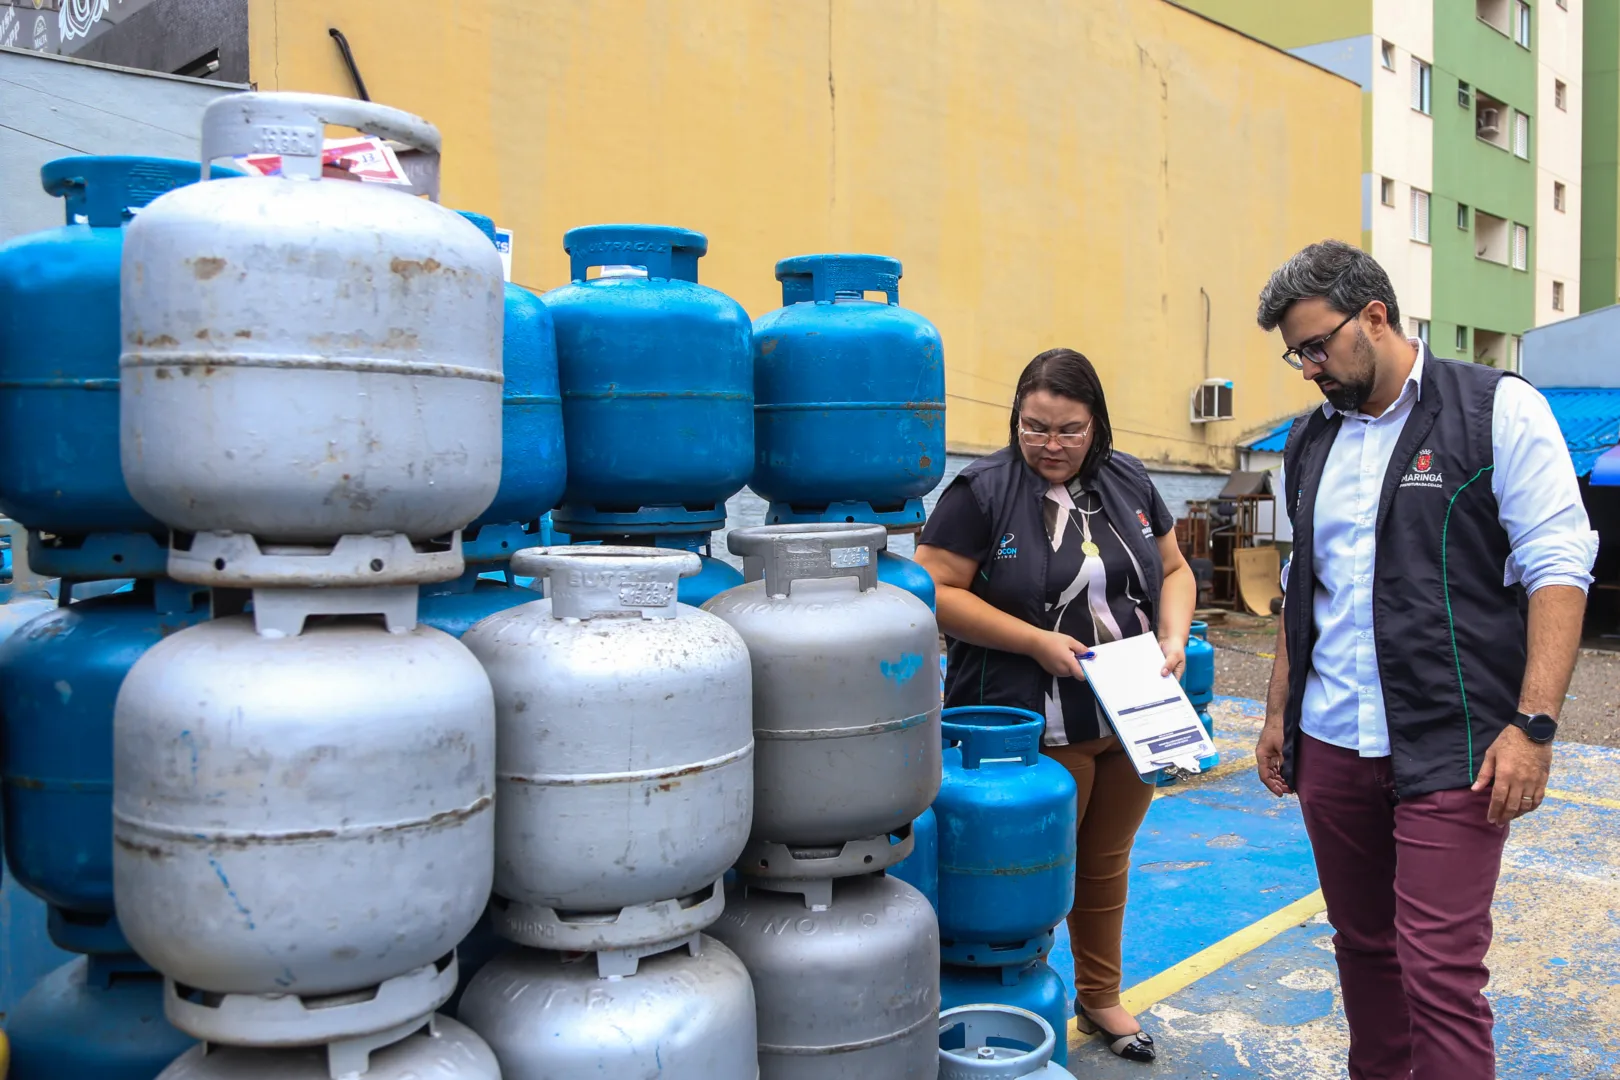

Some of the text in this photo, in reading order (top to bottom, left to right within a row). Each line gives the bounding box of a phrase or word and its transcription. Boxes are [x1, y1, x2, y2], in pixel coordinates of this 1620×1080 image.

[588, 241, 668, 254] ULTRAGAZ
[1401, 473, 1443, 483] MARINGÁ
[995, 547, 1017, 556] OCON
